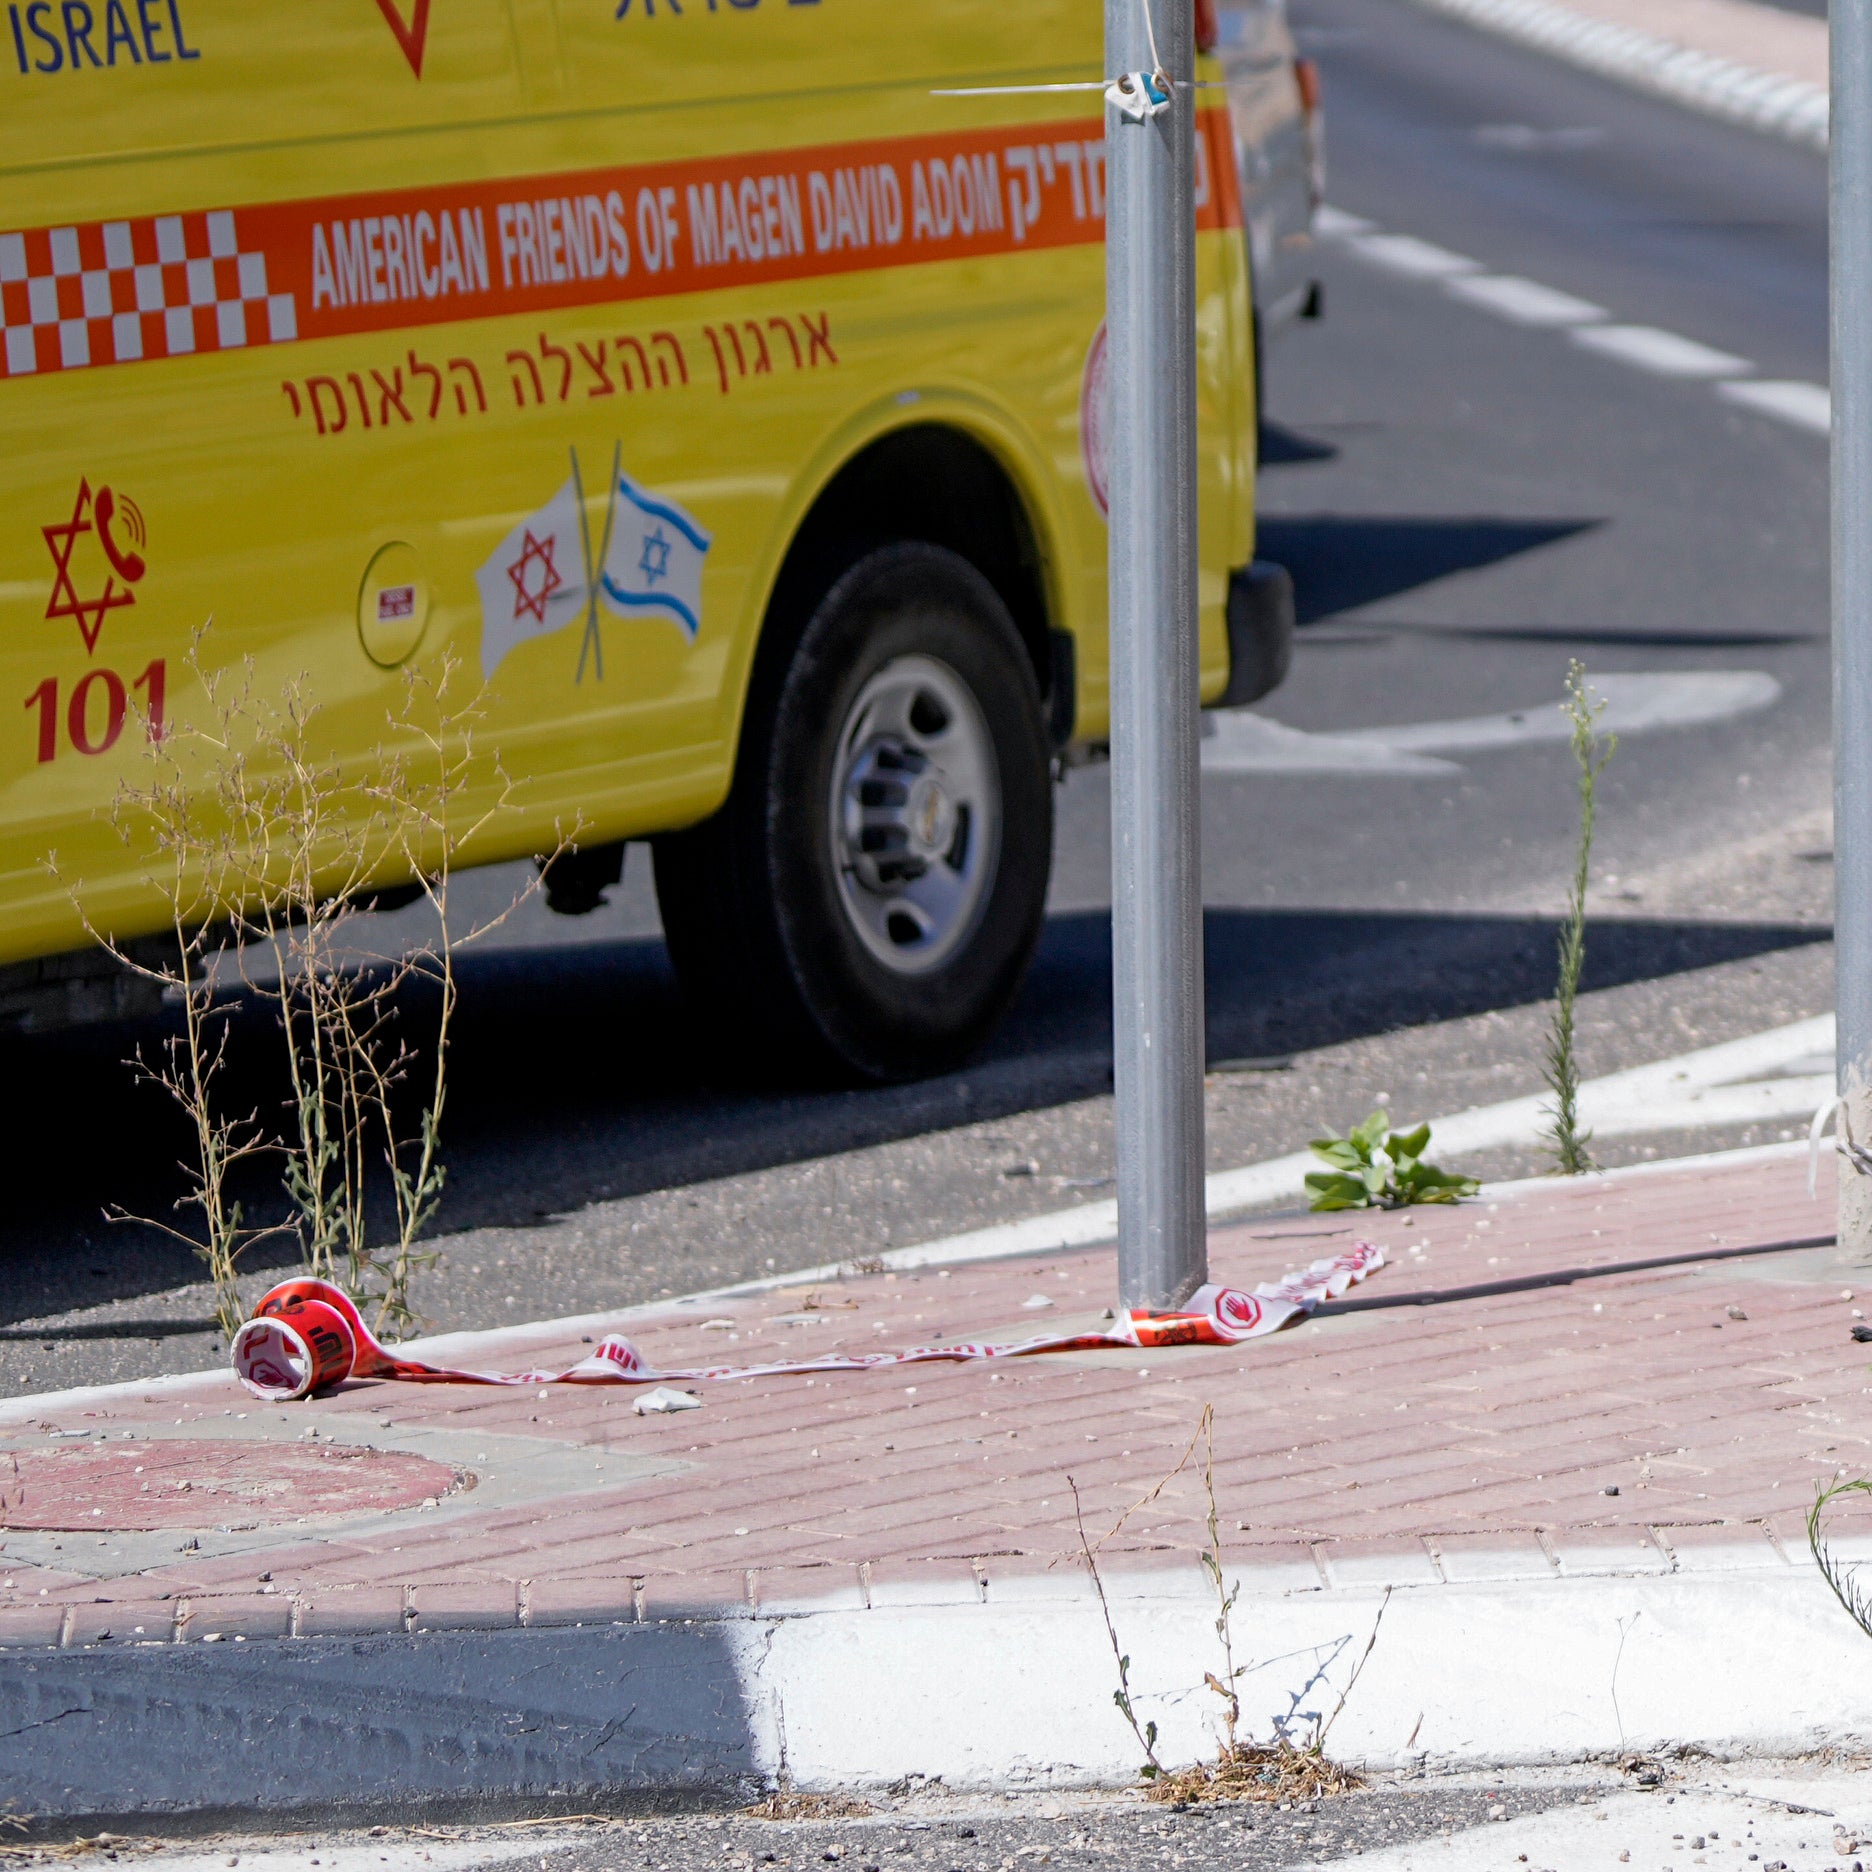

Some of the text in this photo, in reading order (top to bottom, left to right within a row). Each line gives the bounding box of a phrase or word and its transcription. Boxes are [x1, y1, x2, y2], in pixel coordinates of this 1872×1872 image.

[311, 152, 1005, 311] AMERICAN FRIENDS OF MAGEN DAVID ADOM
[281, 311, 840, 436] ארגון ההצלה הלאומי
[24, 657, 167, 764] 101
